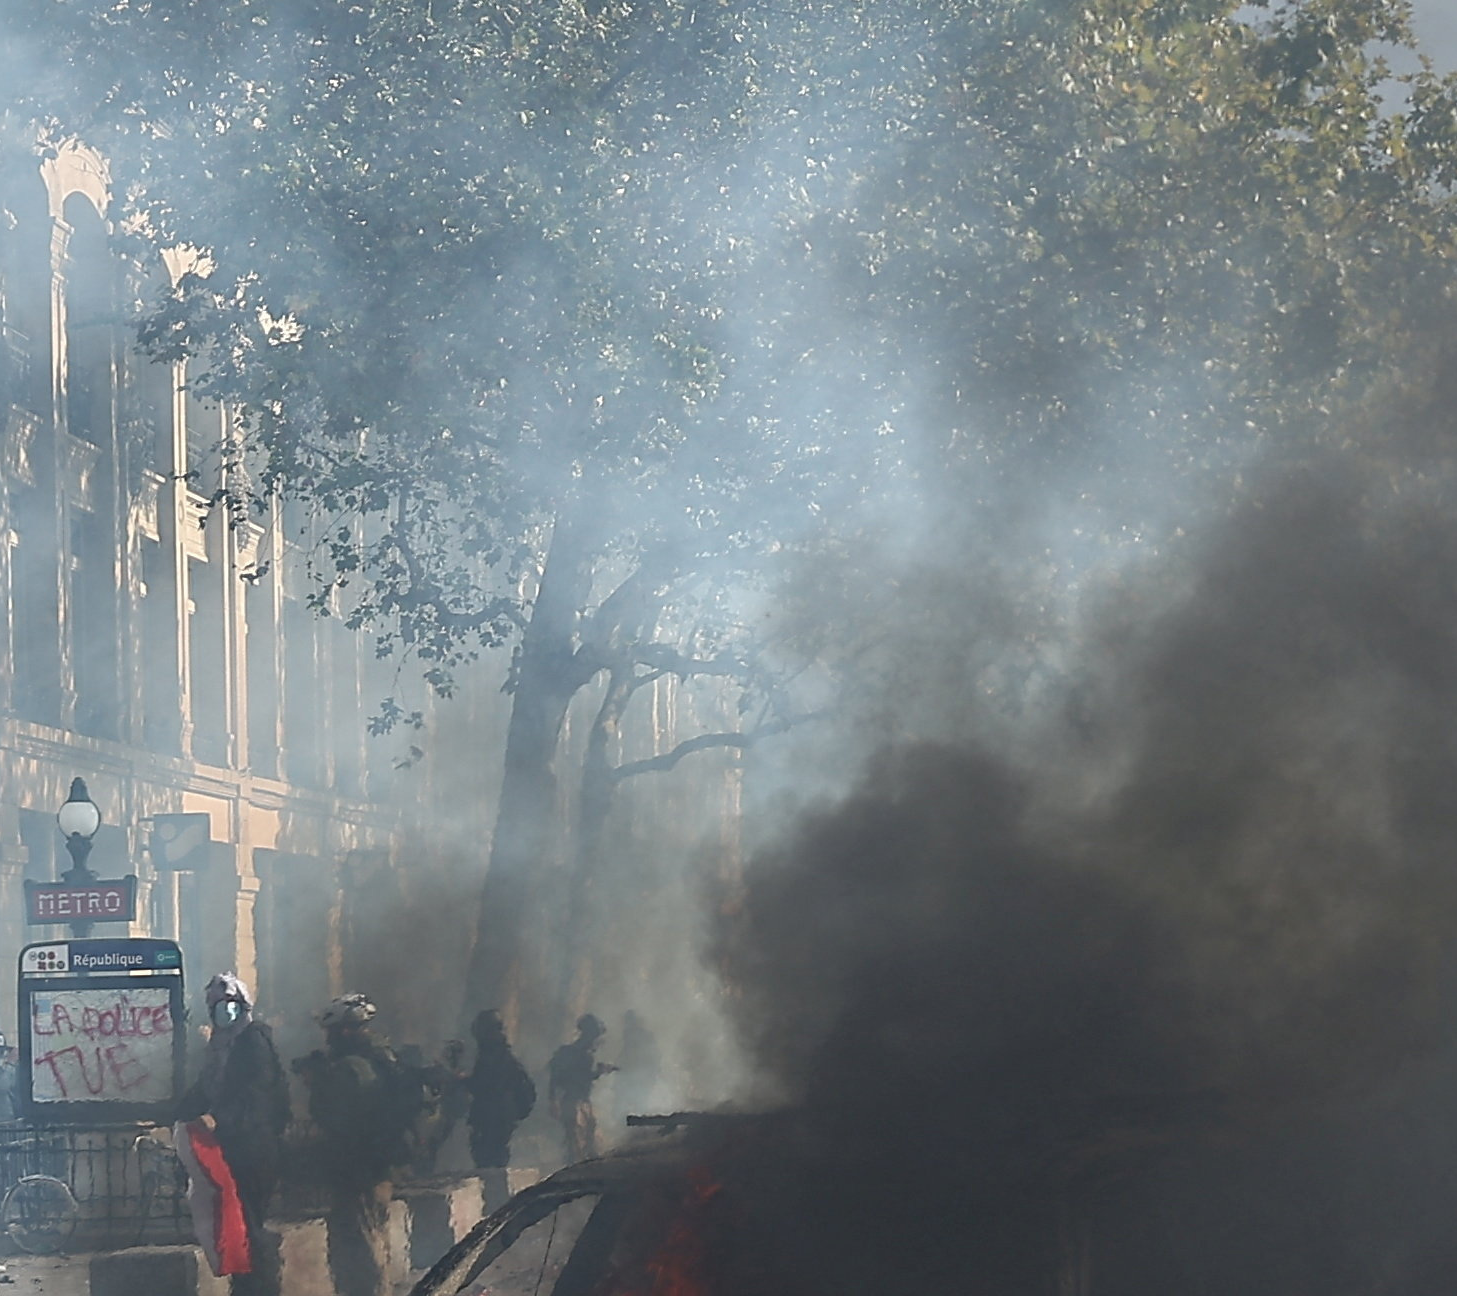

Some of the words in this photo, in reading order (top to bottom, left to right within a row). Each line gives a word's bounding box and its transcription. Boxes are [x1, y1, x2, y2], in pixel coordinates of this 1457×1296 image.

[37, 890, 121, 915] METRO
[73, 953, 144, 968] République
[34, 1003, 74, 1036] LA
[33, 1043, 150, 1098] TUE
